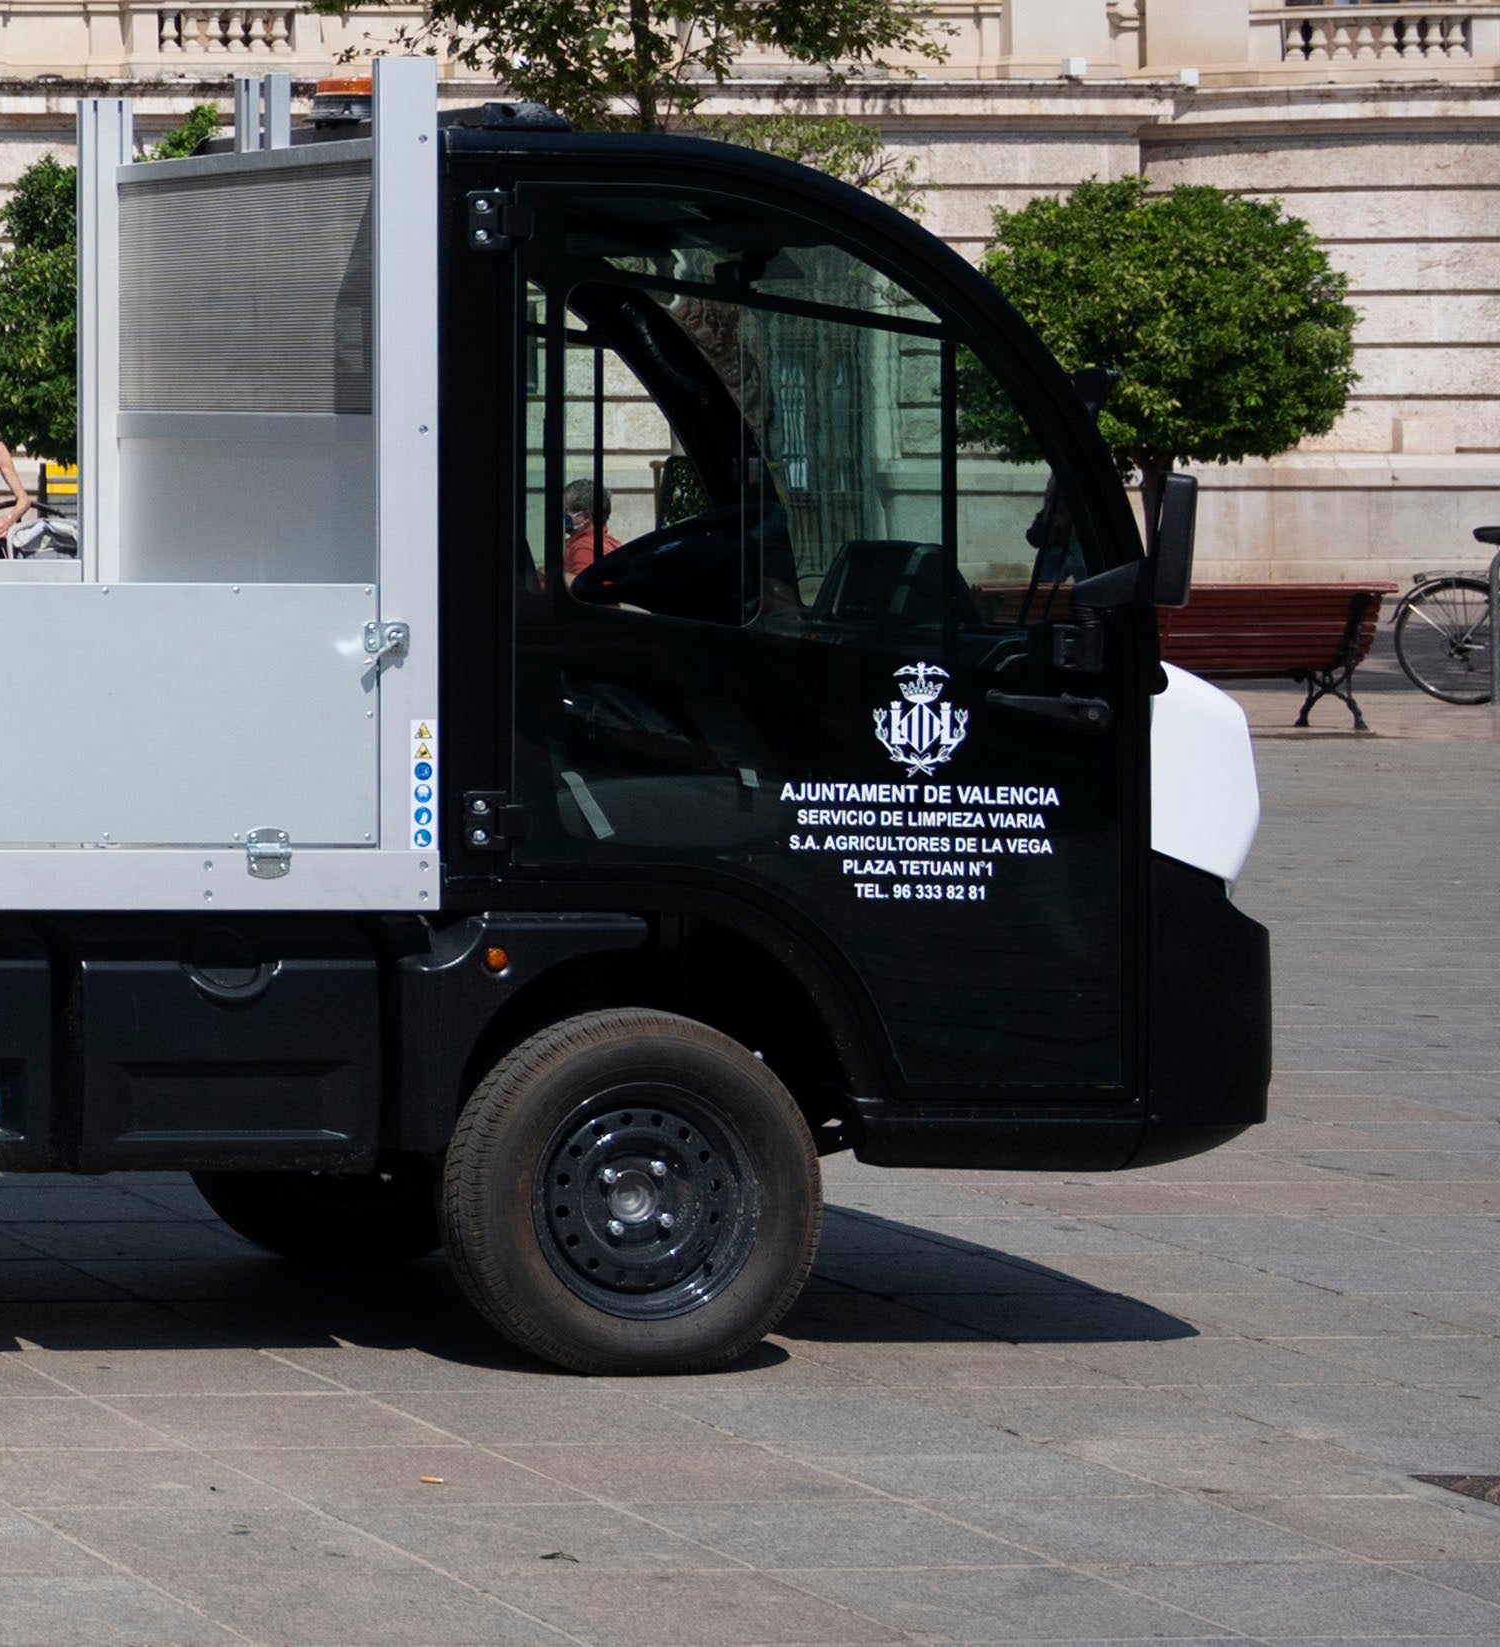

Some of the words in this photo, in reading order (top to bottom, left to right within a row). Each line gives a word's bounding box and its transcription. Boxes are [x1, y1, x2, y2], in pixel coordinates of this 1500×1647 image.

[780, 783, 918, 802] AJUNTAMENT
[924, 785, 951, 803] DE
[957, 786, 1059, 805] VALENCIA
[798, 809, 876, 825] SERVICIO
[881, 811, 903, 826] DE
[908, 812, 985, 827] LIMPIEZA
[988, 813, 1045, 828] VIARIA
[789, 835, 820, 849] S.A.
[824, 835, 950, 852] AGRICULTORES
[955, 838, 977, 852] DE
[982, 838, 1003, 853] LA
[1007, 839, 1052, 853] VEGA
[843, 859, 896, 875] PLAZA
[899, 860, 964, 876] TETUAN
[969, 861, 992, 876] N°1
[854, 883, 888, 898] TEL.
[893, 884, 911, 899] 96
[915, 884, 942, 899] 333
[946, 885, 964, 899] 82
[968, 885, 985, 900] 81
